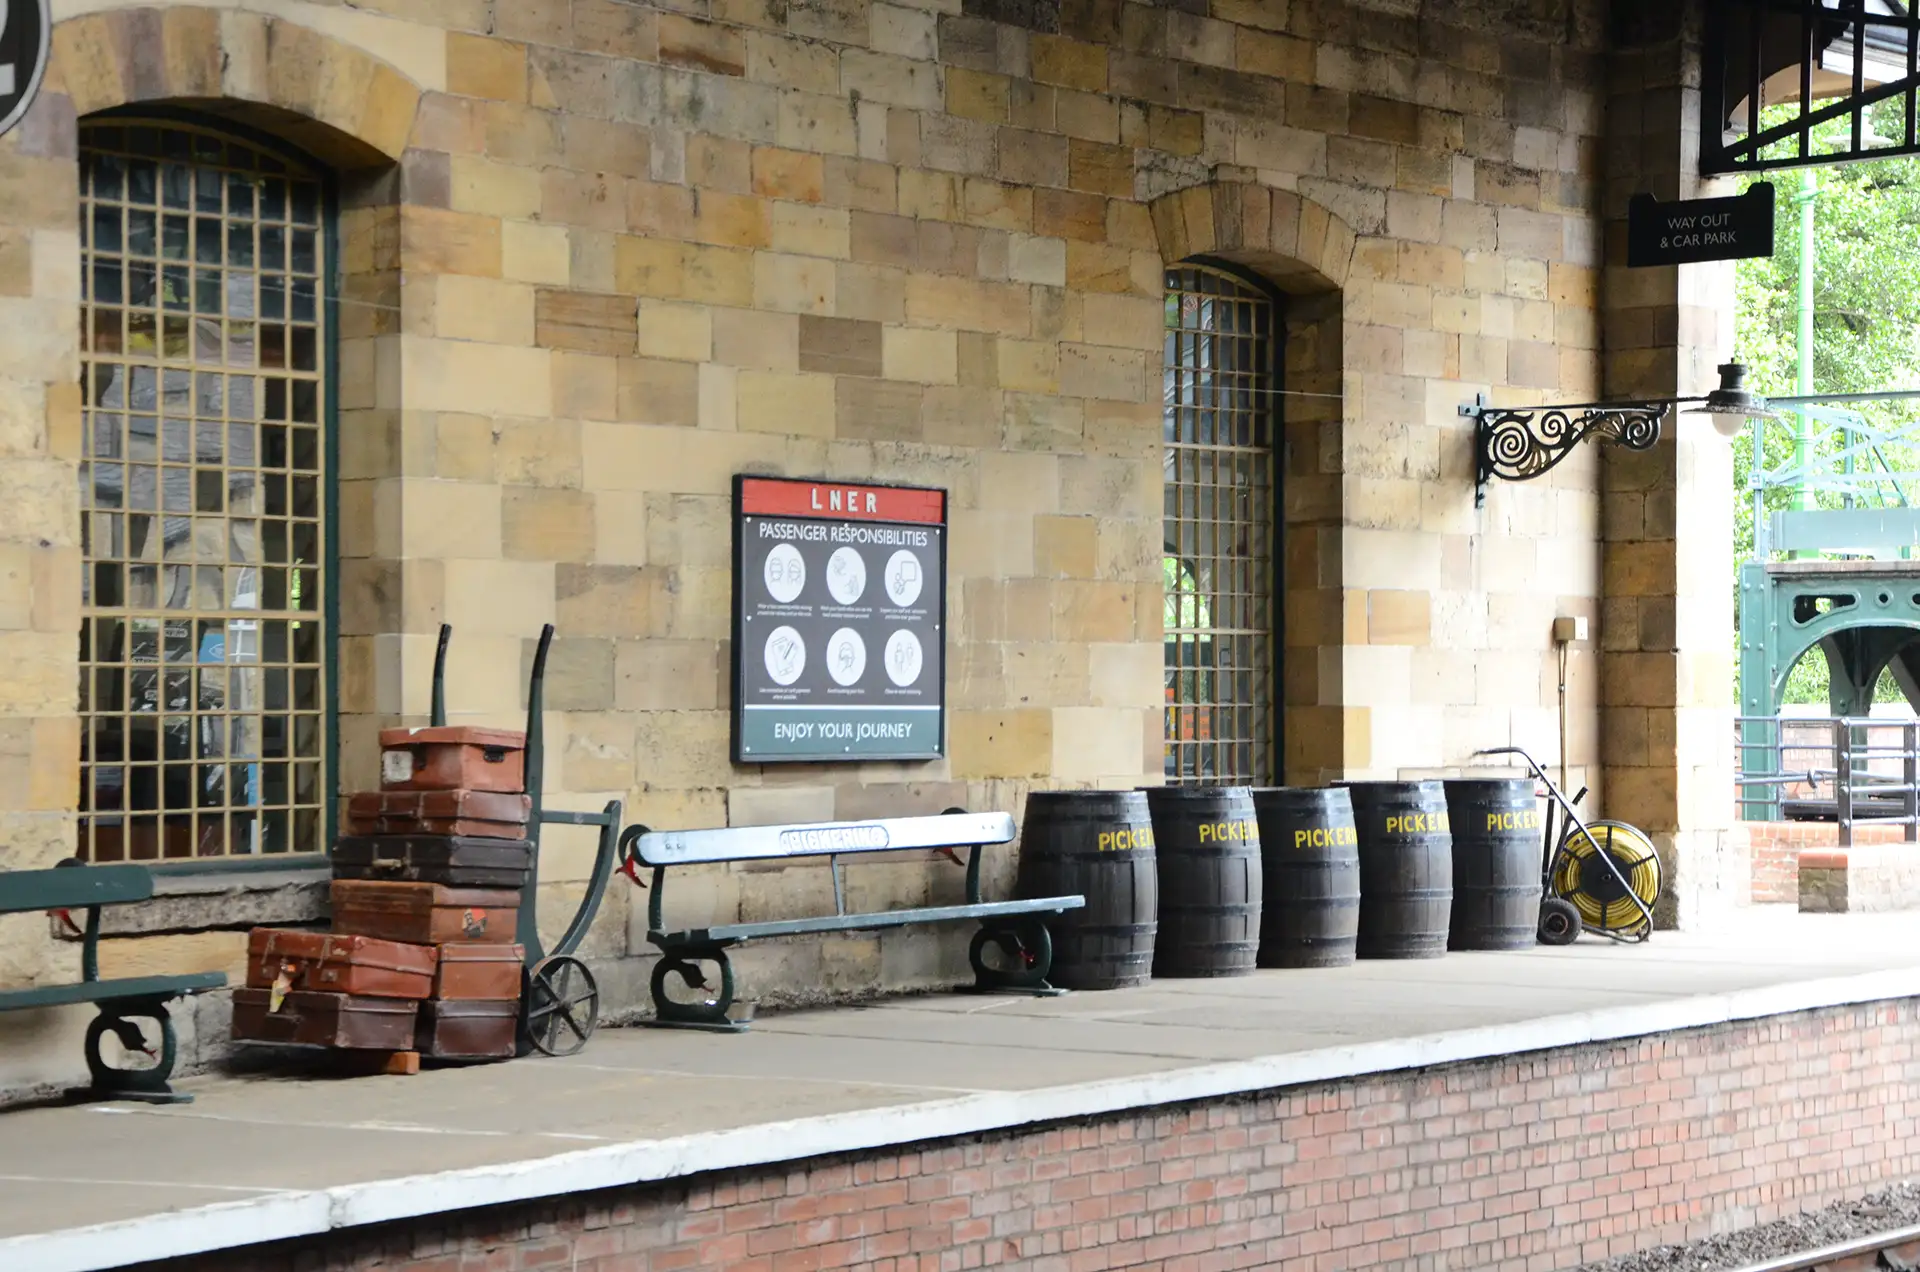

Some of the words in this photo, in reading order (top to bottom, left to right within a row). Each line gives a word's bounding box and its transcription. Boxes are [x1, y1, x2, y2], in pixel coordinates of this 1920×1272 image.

[1667, 215, 1697, 229] WAY
[1700, 212, 1731, 227] OUT
[1660, 236, 1669, 249] &
[1672, 233, 1701, 248] CAR
[1704, 231, 1737, 245] PARK
[811, 487, 877, 513] LNER
[759, 522, 828, 542] PASSENGER
[830, 526, 928, 547] RESPONSIBILITIES
[774, 722, 815, 743] ENJOY
[818, 722, 853, 738] YOUR
[855, 722, 913, 743] JOURNEY
